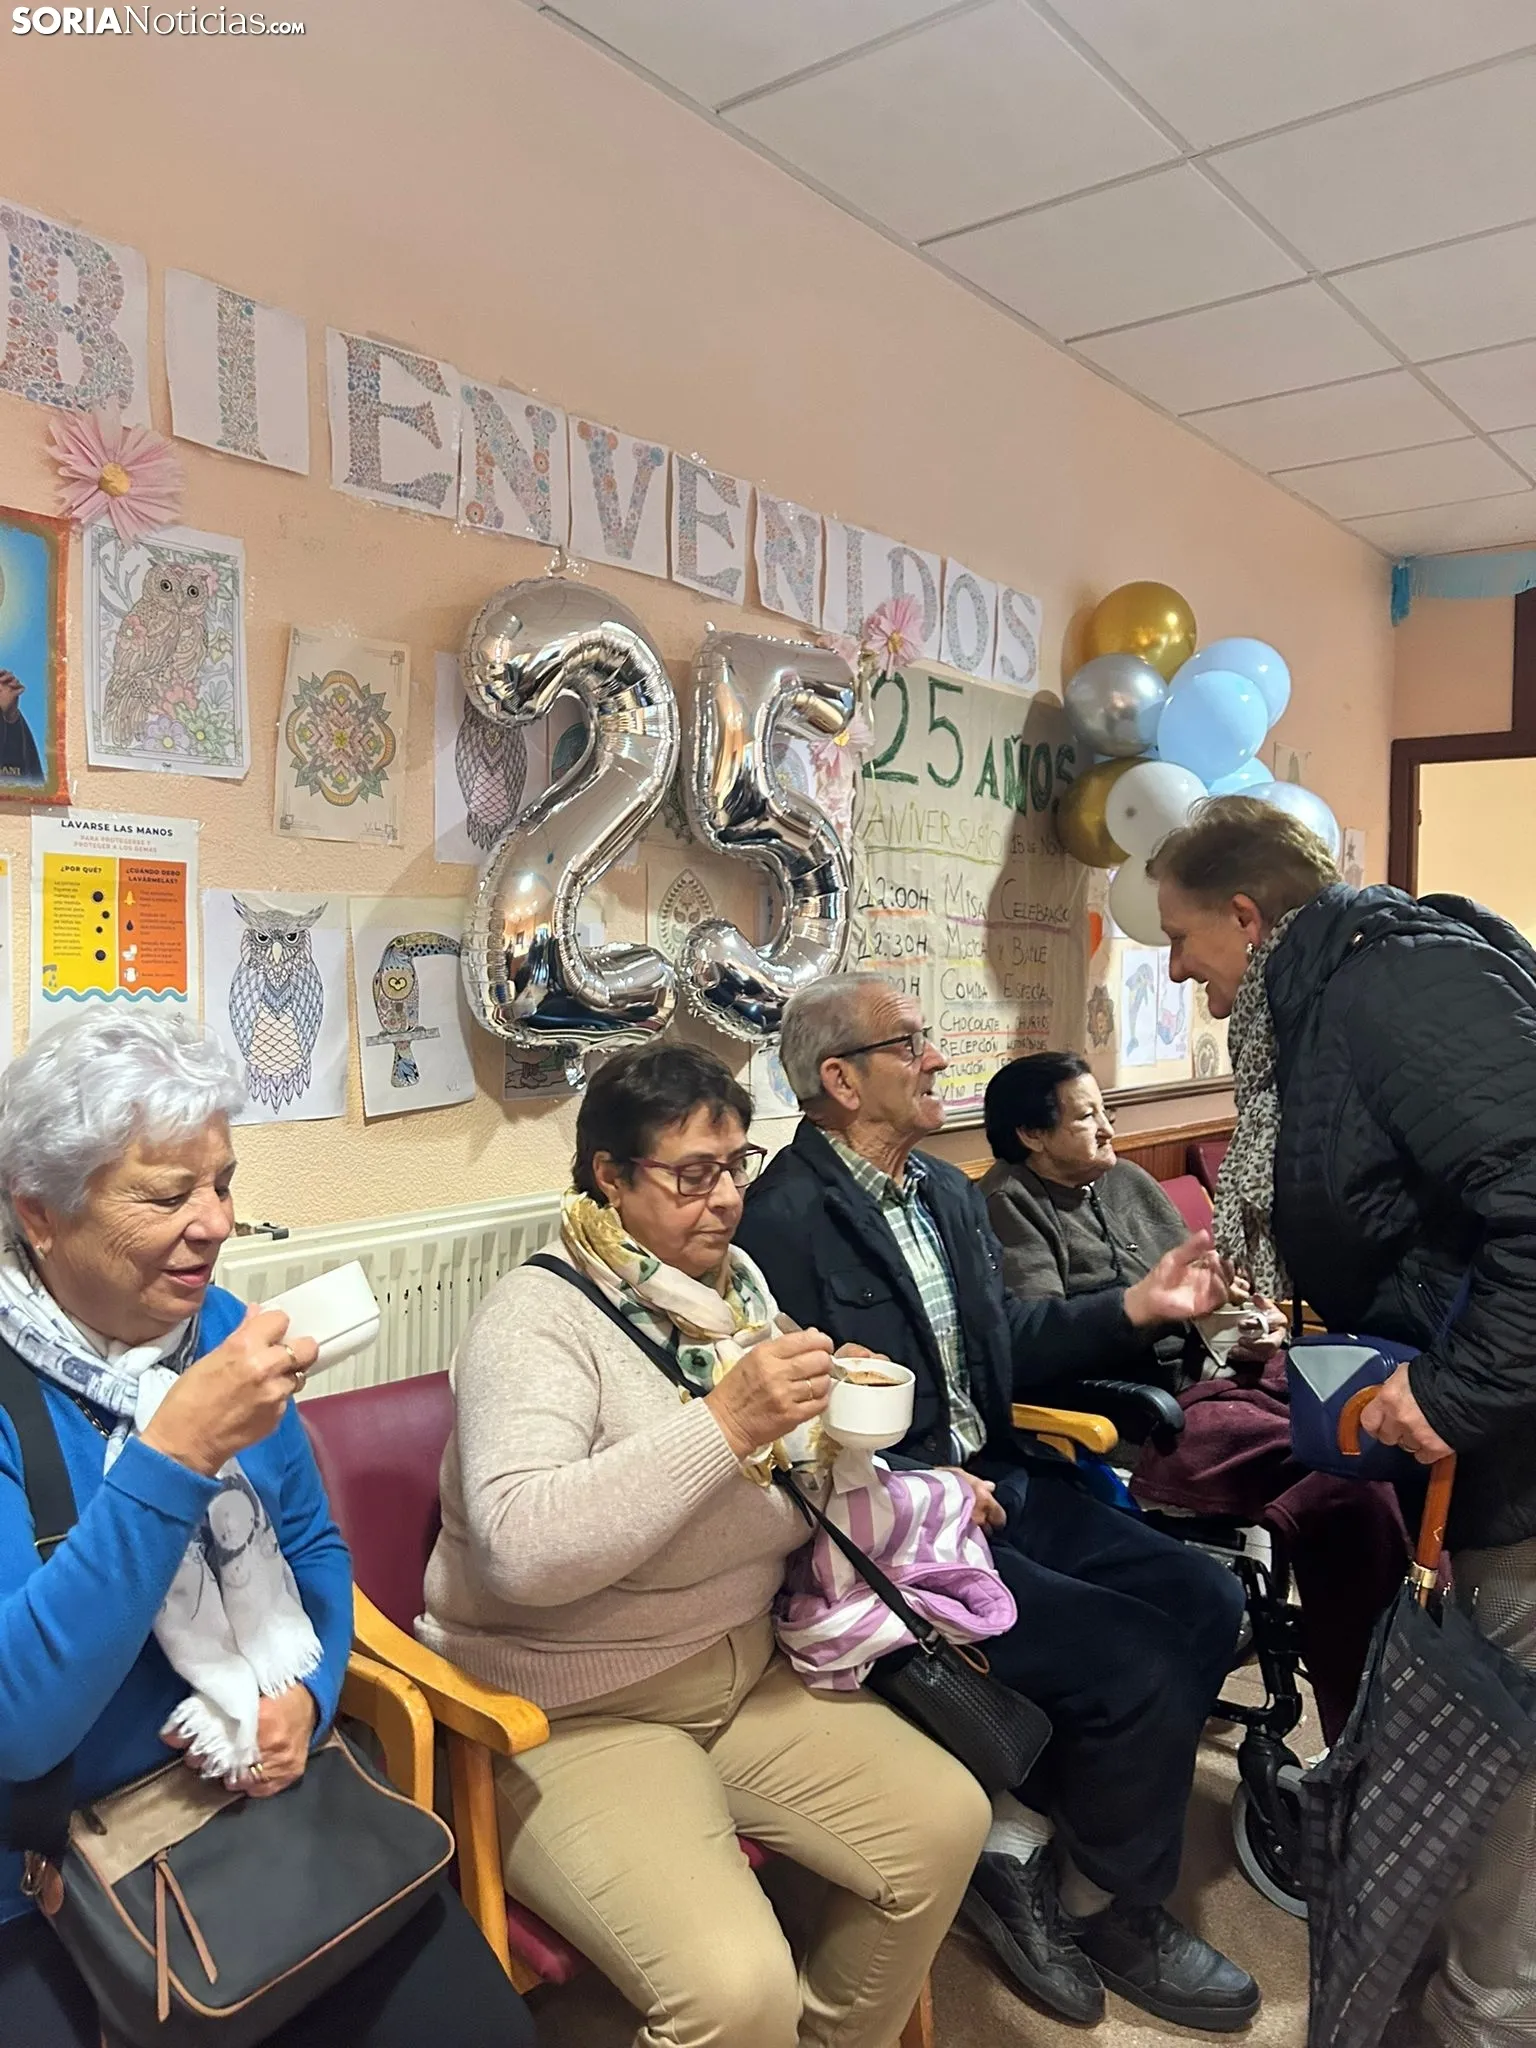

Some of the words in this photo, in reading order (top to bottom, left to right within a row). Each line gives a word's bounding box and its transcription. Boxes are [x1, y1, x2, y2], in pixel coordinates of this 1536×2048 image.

[0, 205, 1038, 685] BIENVENIDOS
[862, 671, 964, 789] 25
[61, 820, 110, 832] LAVARSE
[113, 825, 133, 833] LAS
[136, 827, 173, 837] MANOS
[73, 841, 111, 849] PROTEGER
[939, 1009, 1000, 1032] CHOCOLATE
